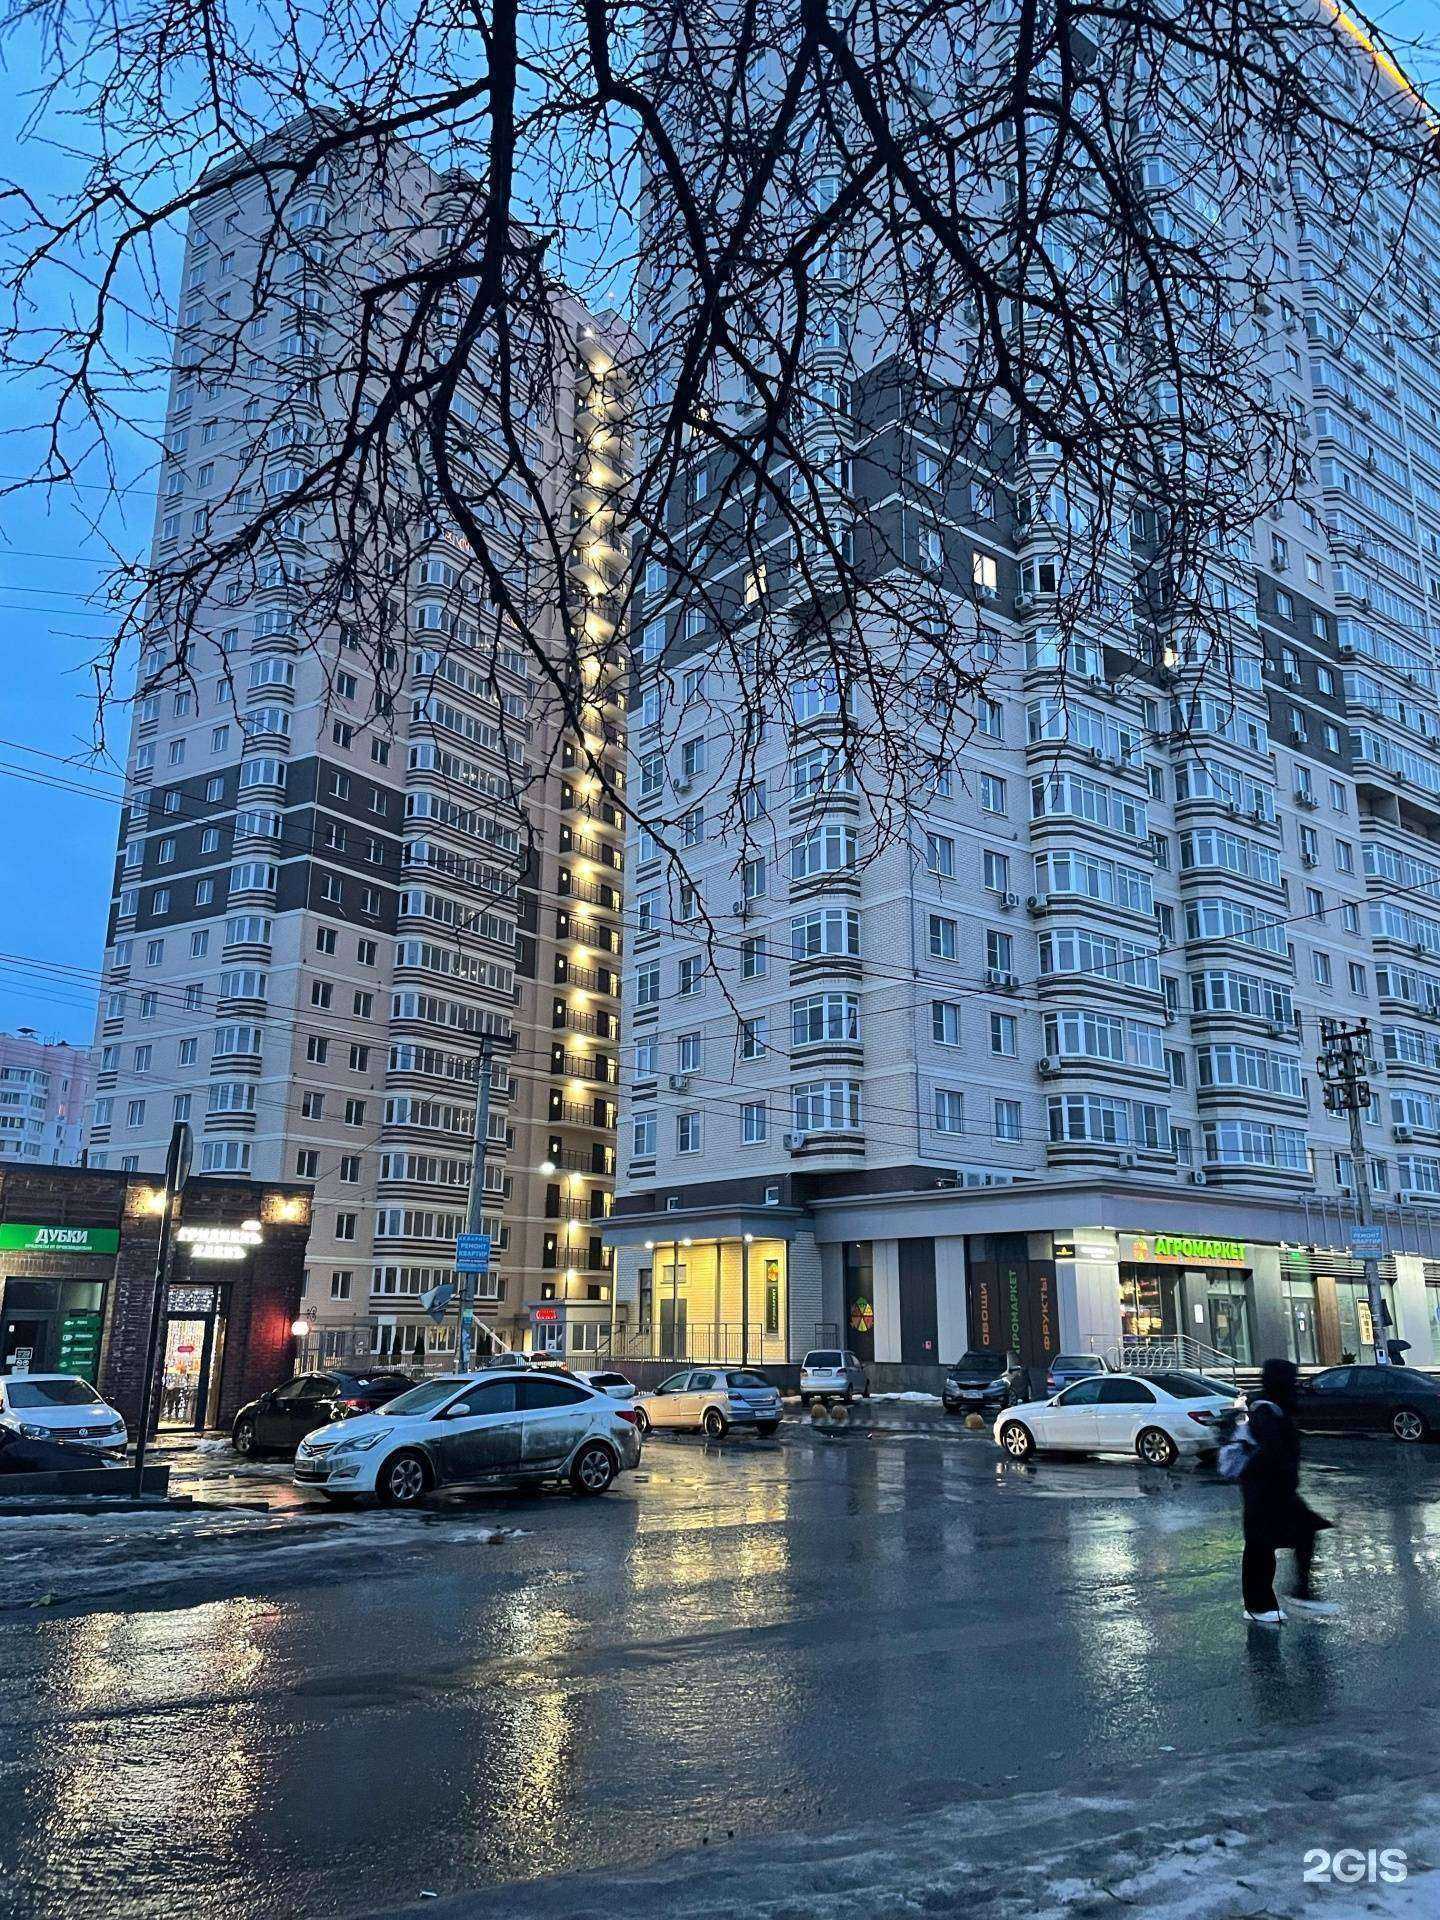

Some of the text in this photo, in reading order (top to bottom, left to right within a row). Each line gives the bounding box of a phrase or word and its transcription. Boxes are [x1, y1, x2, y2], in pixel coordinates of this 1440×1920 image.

[34, 1228, 88, 1244] ДУБКИ
[458, 1250, 488, 1258] КВАРТИР
[460, 1242, 487, 1250] РЕМОНТ
[1154, 1237, 1245, 1260] АГРОМАРКЕТ
[980, 1282, 990, 1345] ОВОЩИ
[1040, 1277, 1051, 1350] ФРУКТЫ
